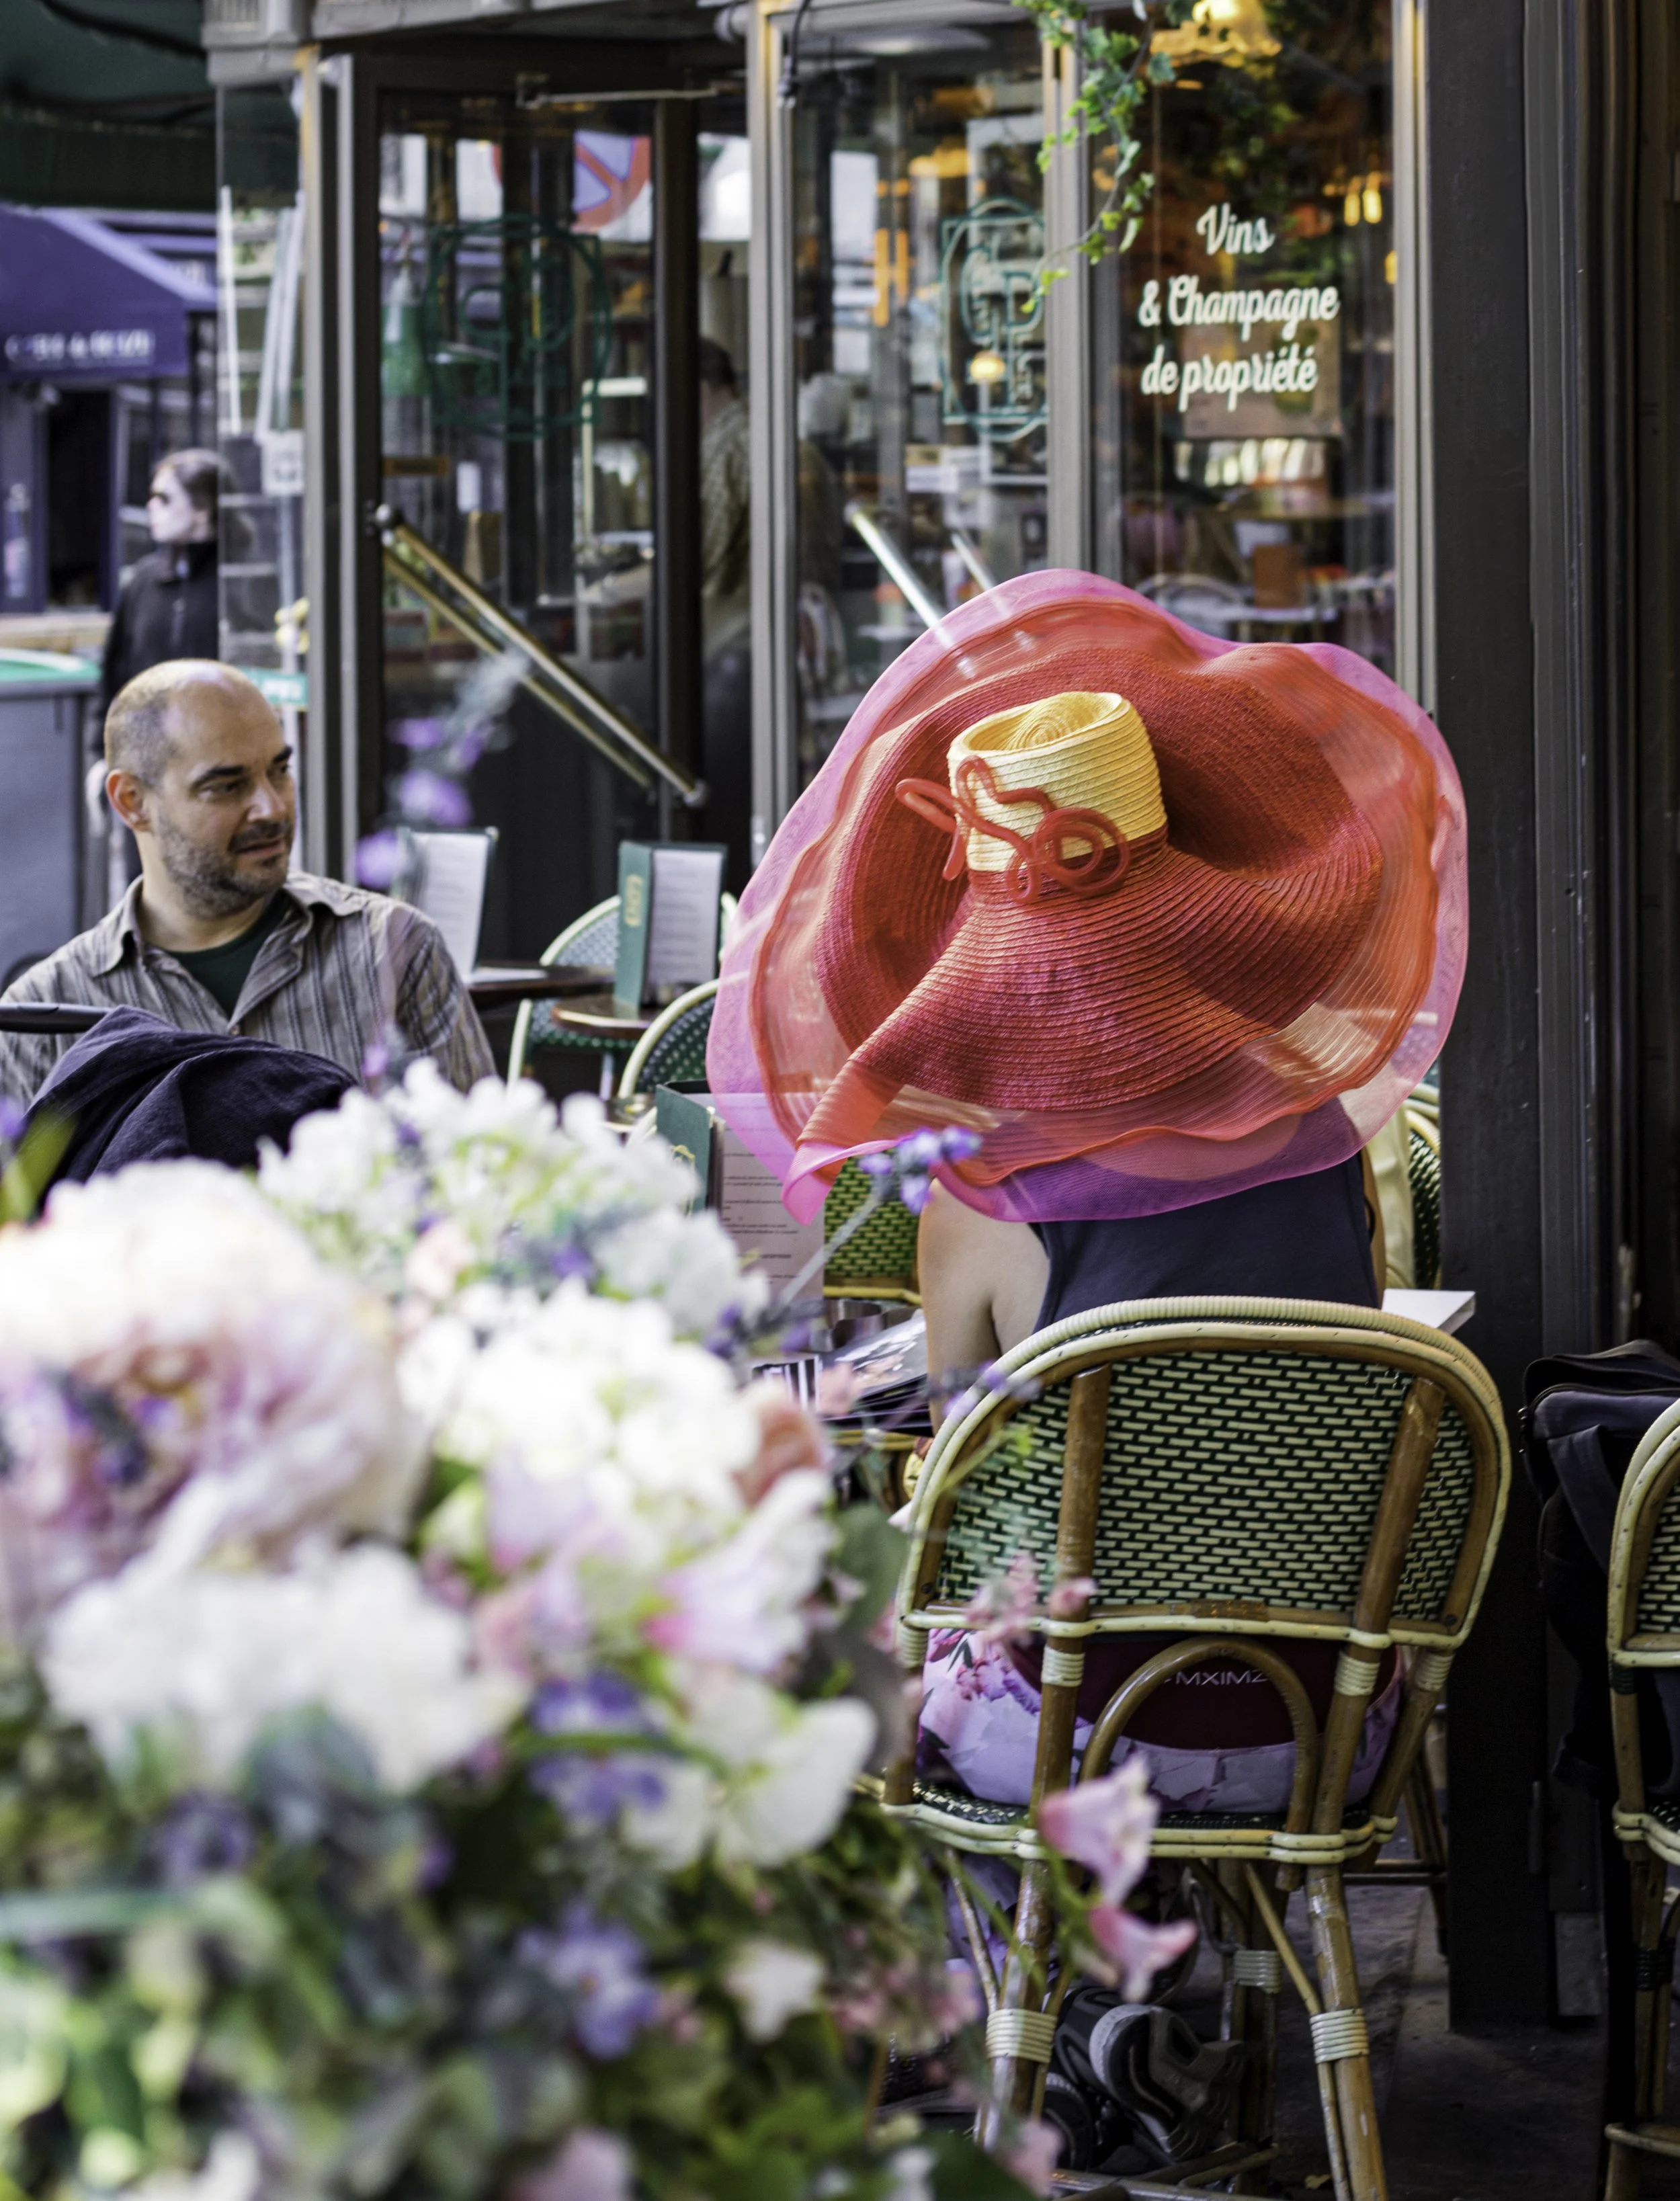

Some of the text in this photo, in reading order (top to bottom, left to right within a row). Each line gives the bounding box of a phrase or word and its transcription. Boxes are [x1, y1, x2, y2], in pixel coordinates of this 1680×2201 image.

[1196, 202, 1275, 255] Vins
[1138, 274, 1341, 342] & Champagne
[1140, 342, 1318, 413] de propriété
